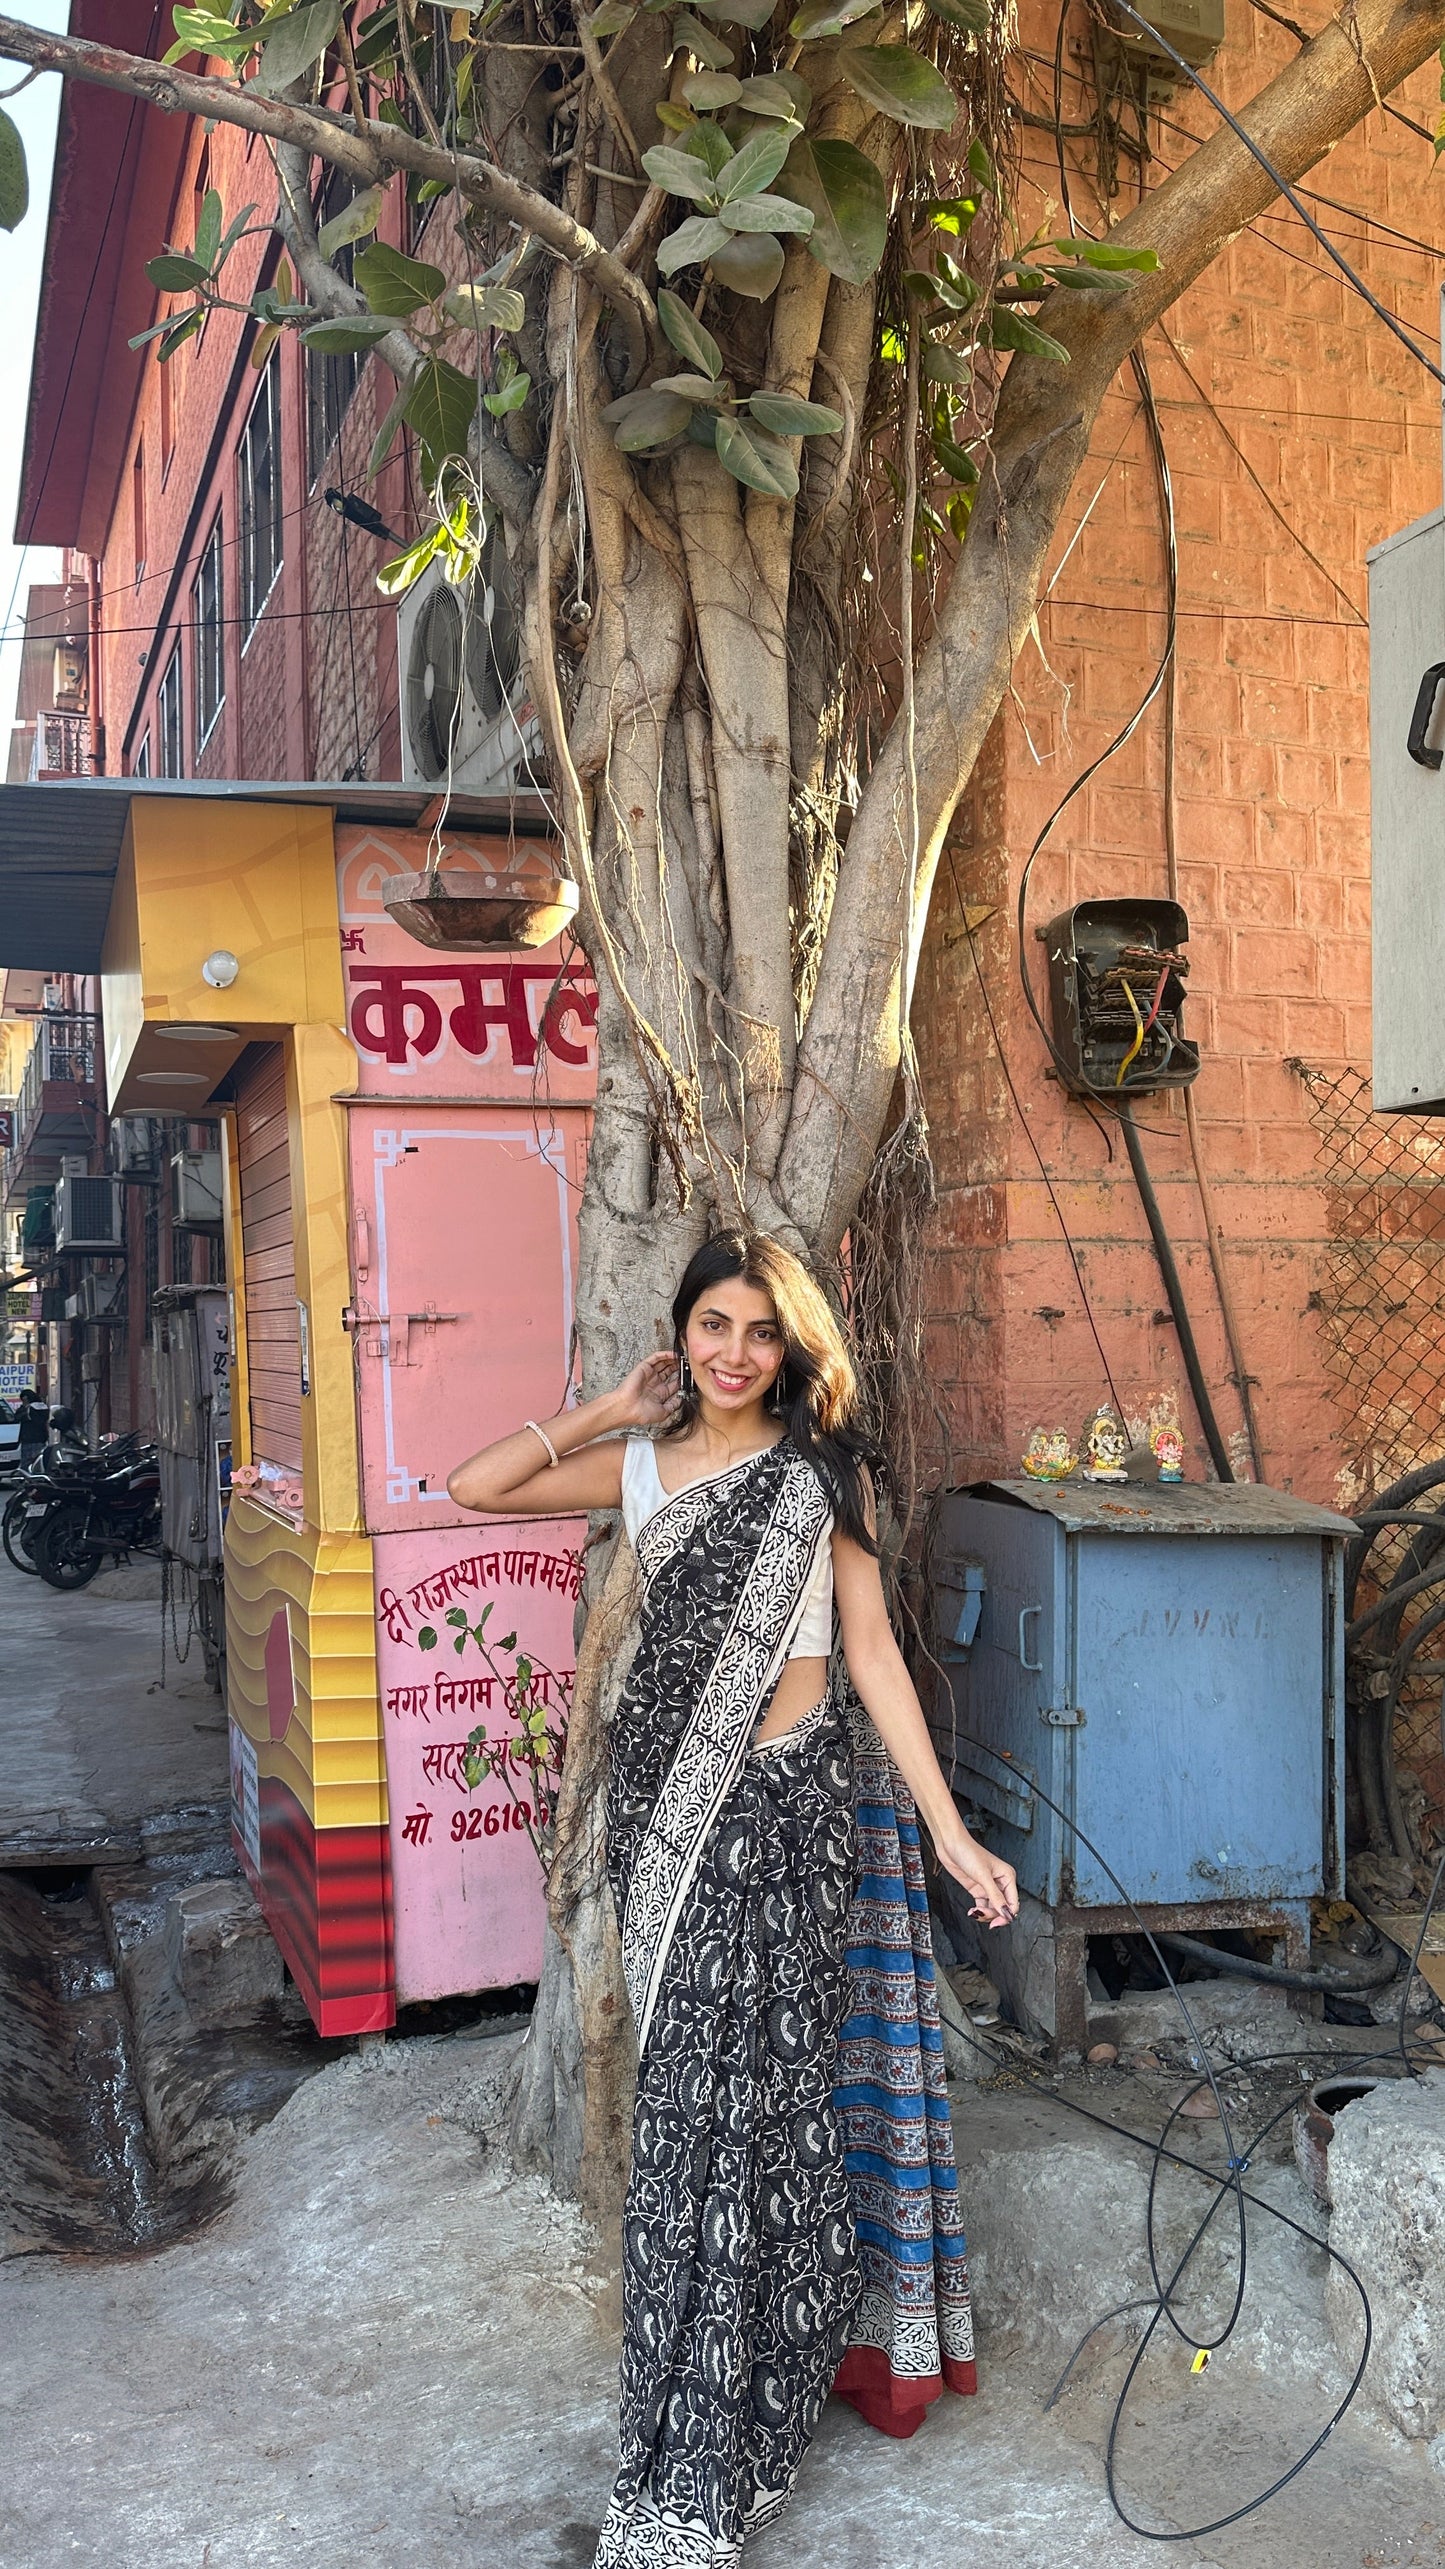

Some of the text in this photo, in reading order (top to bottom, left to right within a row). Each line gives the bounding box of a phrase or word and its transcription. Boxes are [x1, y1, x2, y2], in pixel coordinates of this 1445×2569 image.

[0, 1376, 32, 1386] OTEL
[503, 1550, 541, 1588] पान
[386, 1684, 431, 1723] नगर
[433, 1671, 498, 1715] निगम
